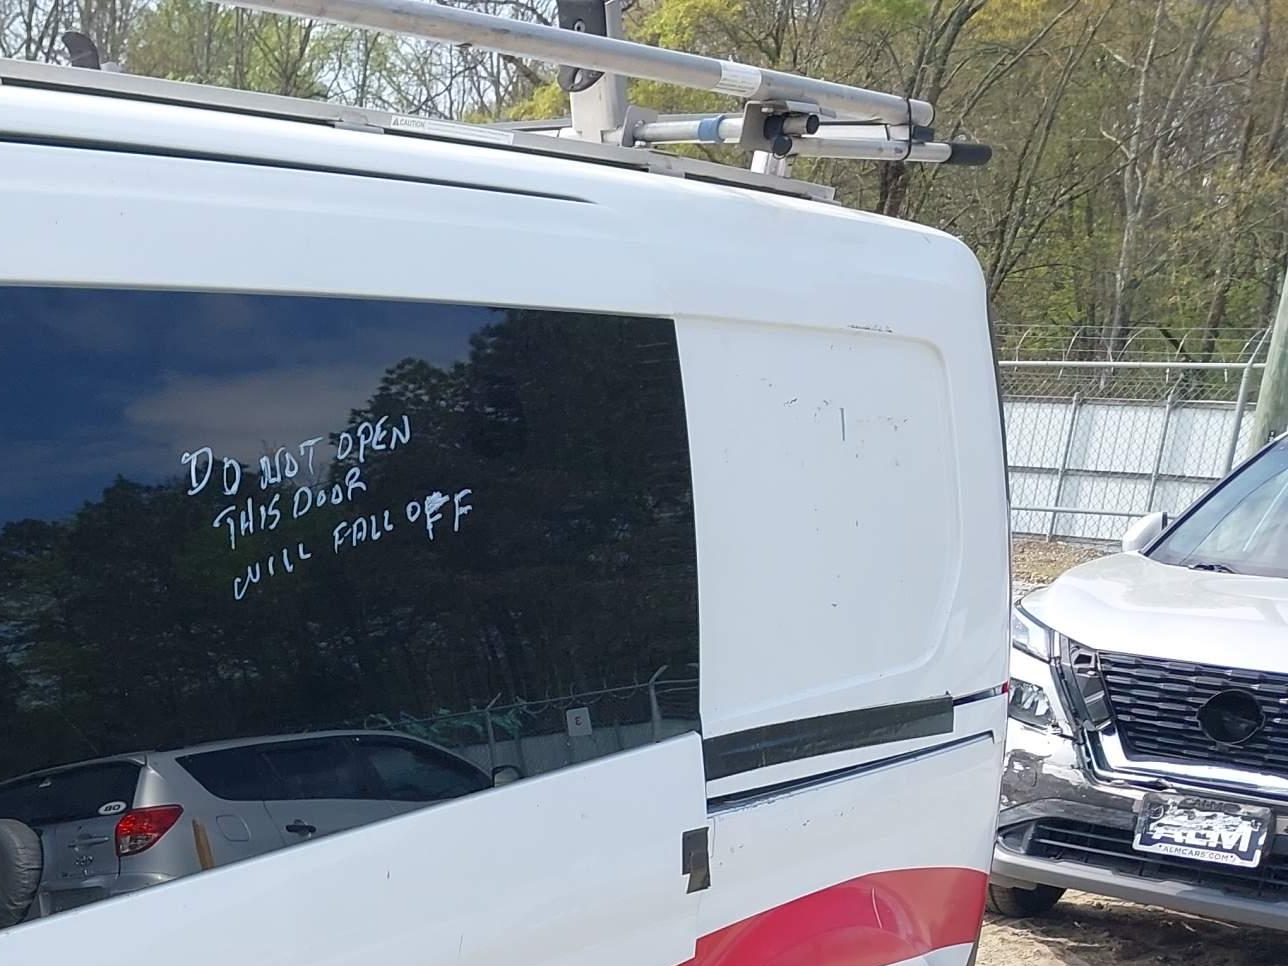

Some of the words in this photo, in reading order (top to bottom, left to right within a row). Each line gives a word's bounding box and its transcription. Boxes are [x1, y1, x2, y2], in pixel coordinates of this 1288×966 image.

[399, 119, 425, 129] CAUTION
[181, 447, 241, 496] DO
[260, 436, 323, 490] NOT
[336, 415, 410, 463] OPEN
[213, 494, 280, 550] THIS
[293, 466, 367, 519] DOOR
[234, 543, 312, 600] WILL
[333, 510, 394, 553] FALL
[406, 489, 473, 540] OFF
